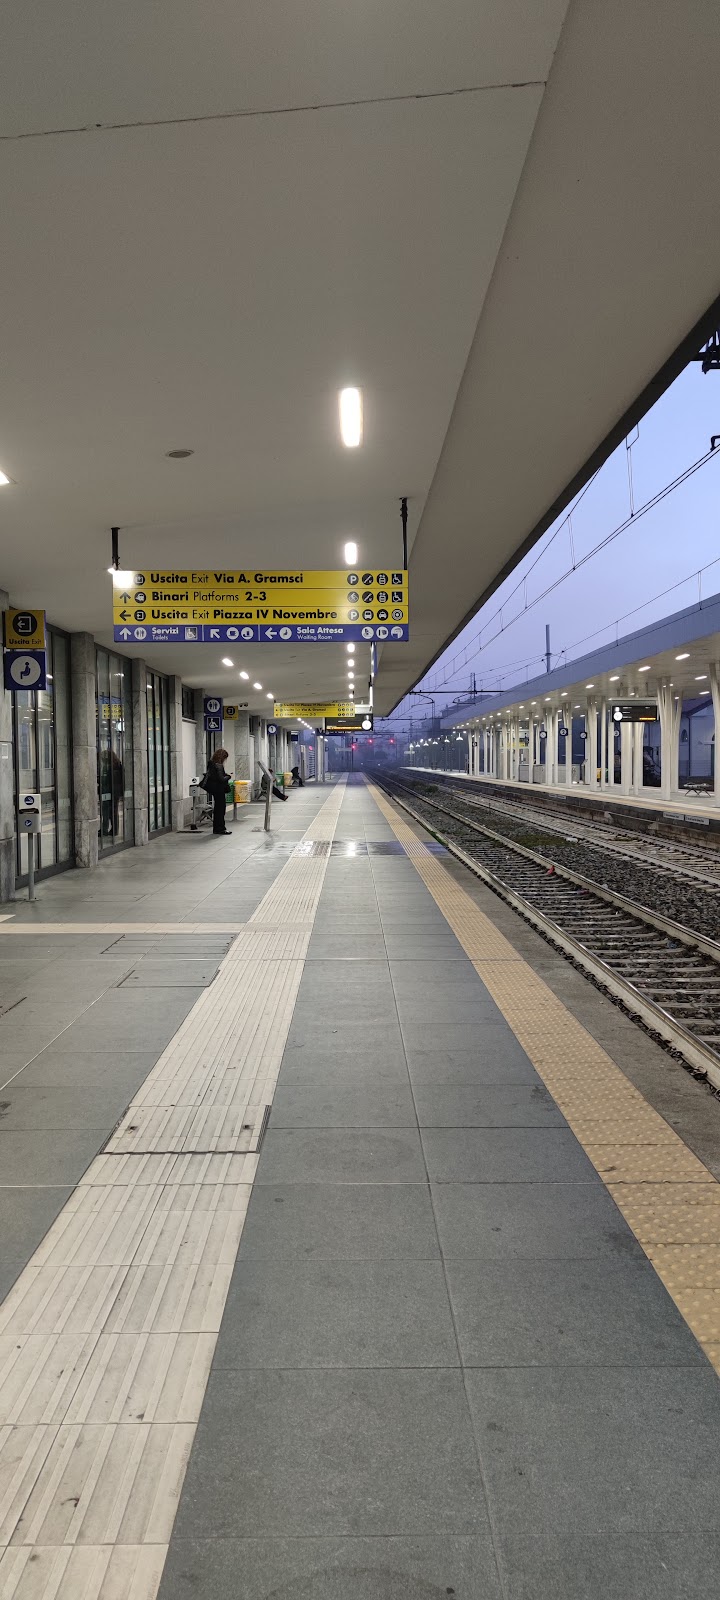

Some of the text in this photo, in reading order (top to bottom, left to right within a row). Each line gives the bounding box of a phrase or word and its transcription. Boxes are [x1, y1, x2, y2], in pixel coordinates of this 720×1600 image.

[150, 573, 304, 583] Uscita Exit Via A. Gramsci
[152, 591, 266, 601] Binari Platforms 2-3
[152, 609, 338, 619] Uscita Exit Piazza IV Novembre
